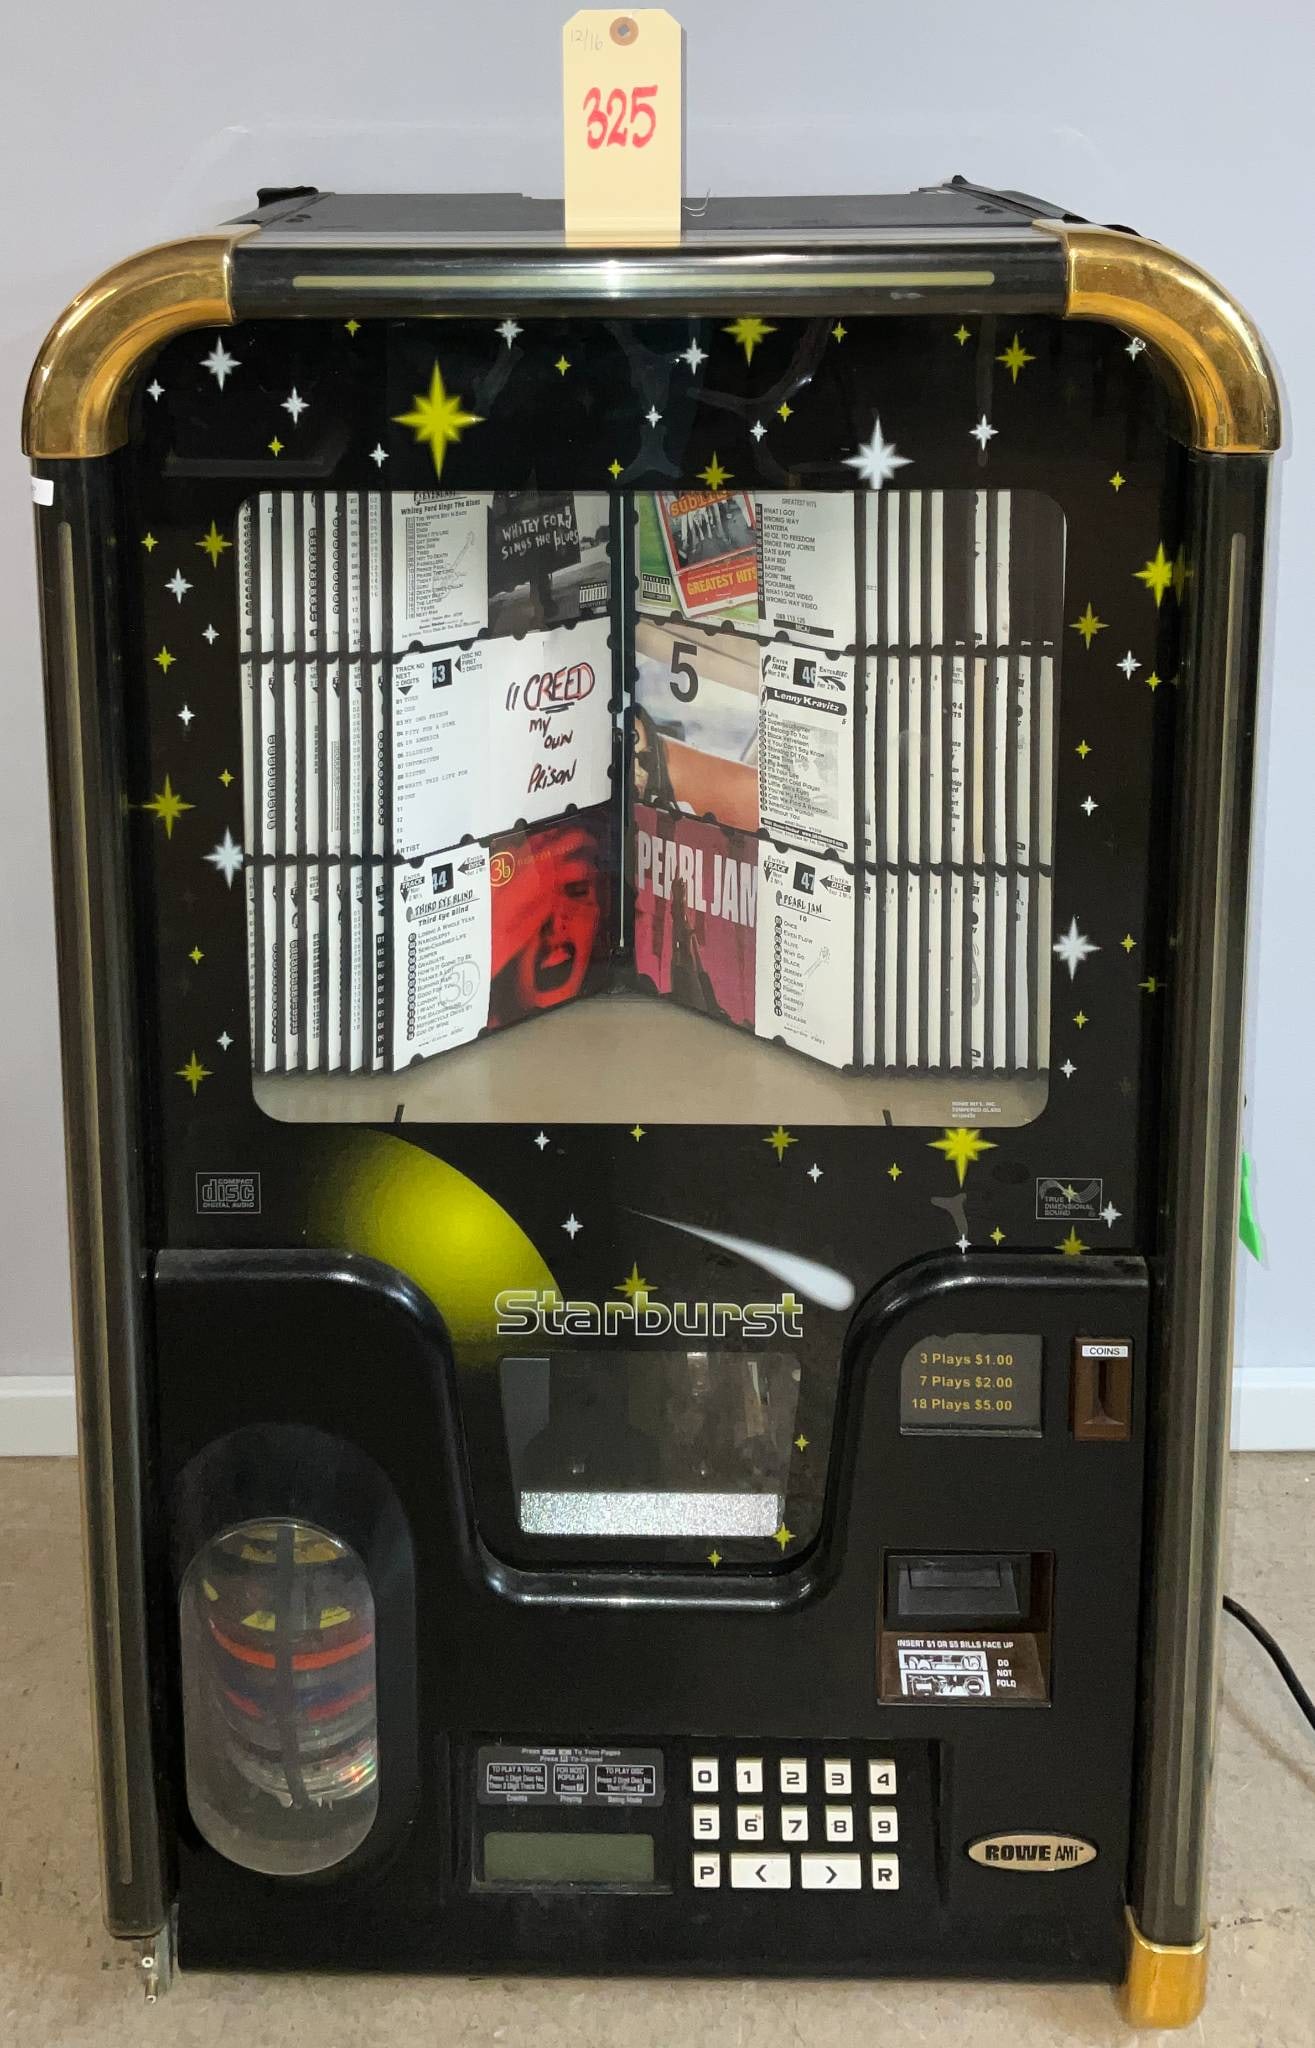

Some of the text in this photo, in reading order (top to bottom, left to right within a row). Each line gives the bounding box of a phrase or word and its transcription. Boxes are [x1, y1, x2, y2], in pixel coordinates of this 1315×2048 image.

[583, 85, 658, 150] 325
[783, 509, 796, 517] GOT
[687, 572, 733, 595] GREATEST
[796, 593, 814, 601] VIDEO
[801, 602, 818, 611] VIDEO
[461, 652, 474, 660] DISC
[462, 658, 476, 666] FIRST
[396, 664, 416, 673] TRACK
[669, 641, 699, 703] 5
[771, 663, 788, 672] TRACK
[396, 671, 411, 680] NEXT
[400, 677, 421, 686] DIGITS
[774, 690, 840, 712] Lenny Kravitz
[637, 829, 707, 913] PEARL
[711, 855, 759, 928] JAM
[801, 872, 816, 891] 47
[415, 889, 474, 917] THIRD EYE BLIND
[784, 894, 822, 914] PEARL JAM
[419, 904, 469, 927] Third Eye Blind
[494, 1290, 804, 1337] Starburst
[1089, 1346, 1121, 1357] COINS
[920, 1353, 1014, 1368] 3 Plays $1.00
[919, 1376, 1014, 1391] 7 Plays $2.00
[911, 1398, 1013, 1413] 18 Plays $5.00
[897, 1639, 924, 1648] INSERT
[936, 1640, 948, 1648] OR
[960, 1640, 982, 1649] BILLS
[982, 1641, 1002, 1649] FACE
[1003, 1641, 1014, 1649] UP
[997, 1659, 1010, 1667] DO
[996, 1669, 1013, 1677] NOT
[996, 1679, 1017, 1688] FOLD
[614, 1767, 630, 1775] PLAY
[698, 1770, 712, 1784] 0
[743, 1770, 752, 1784] 1
[786, 1771, 800, 1785] 2
[831, 1772, 845, 1786] 3
[877, 1773, 890, 1786] 4
[699, 1818, 713, 1832] 5
[744, 1819, 758, 1832] 6
[788, 1820, 802, 1834] 7
[833, 1820, 847, 1833] 8
[877, 1820, 891, 1834] 9
[985, 1845, 1051, 1861] ROWE
[700, 1866, 715, 1880] P
[878, 1868, 893, 1882] R
